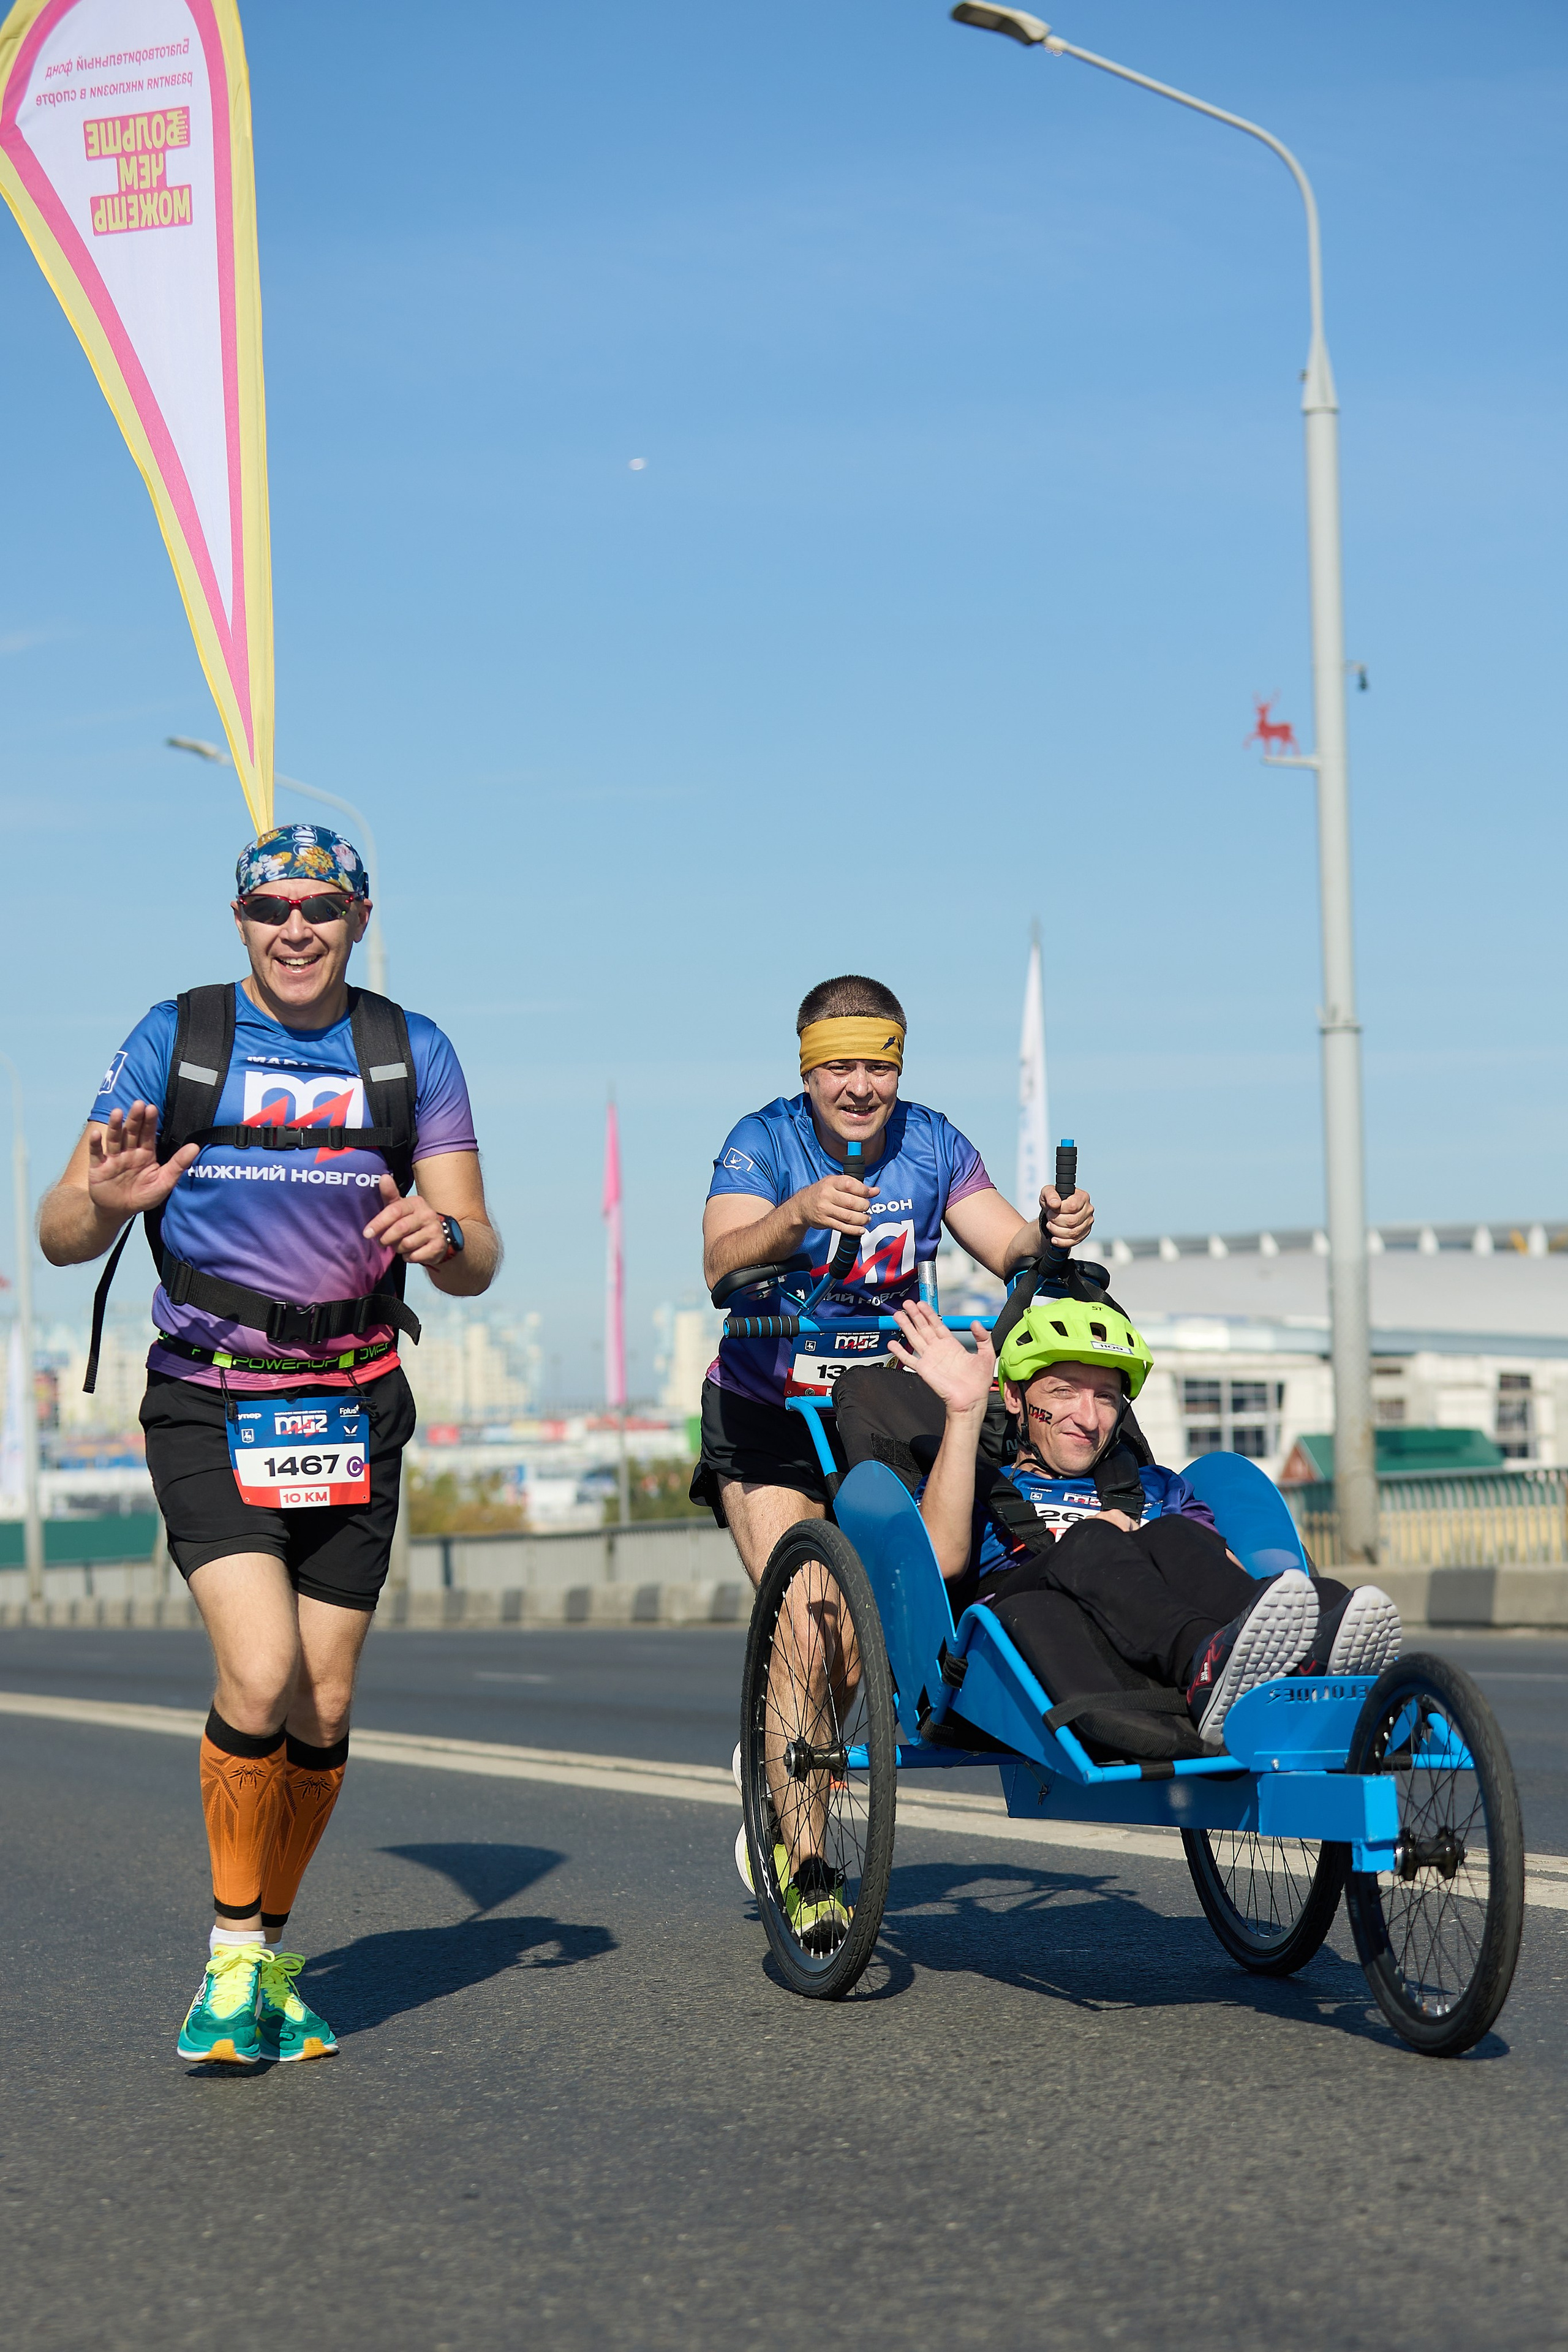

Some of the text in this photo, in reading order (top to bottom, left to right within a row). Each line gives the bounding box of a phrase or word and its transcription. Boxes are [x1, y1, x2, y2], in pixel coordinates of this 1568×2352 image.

[290, 1169, 382, 1188] НОВГОР
[264, 1453, 341, 1477] 1467
[283, 1493, 301, 1504] 10
